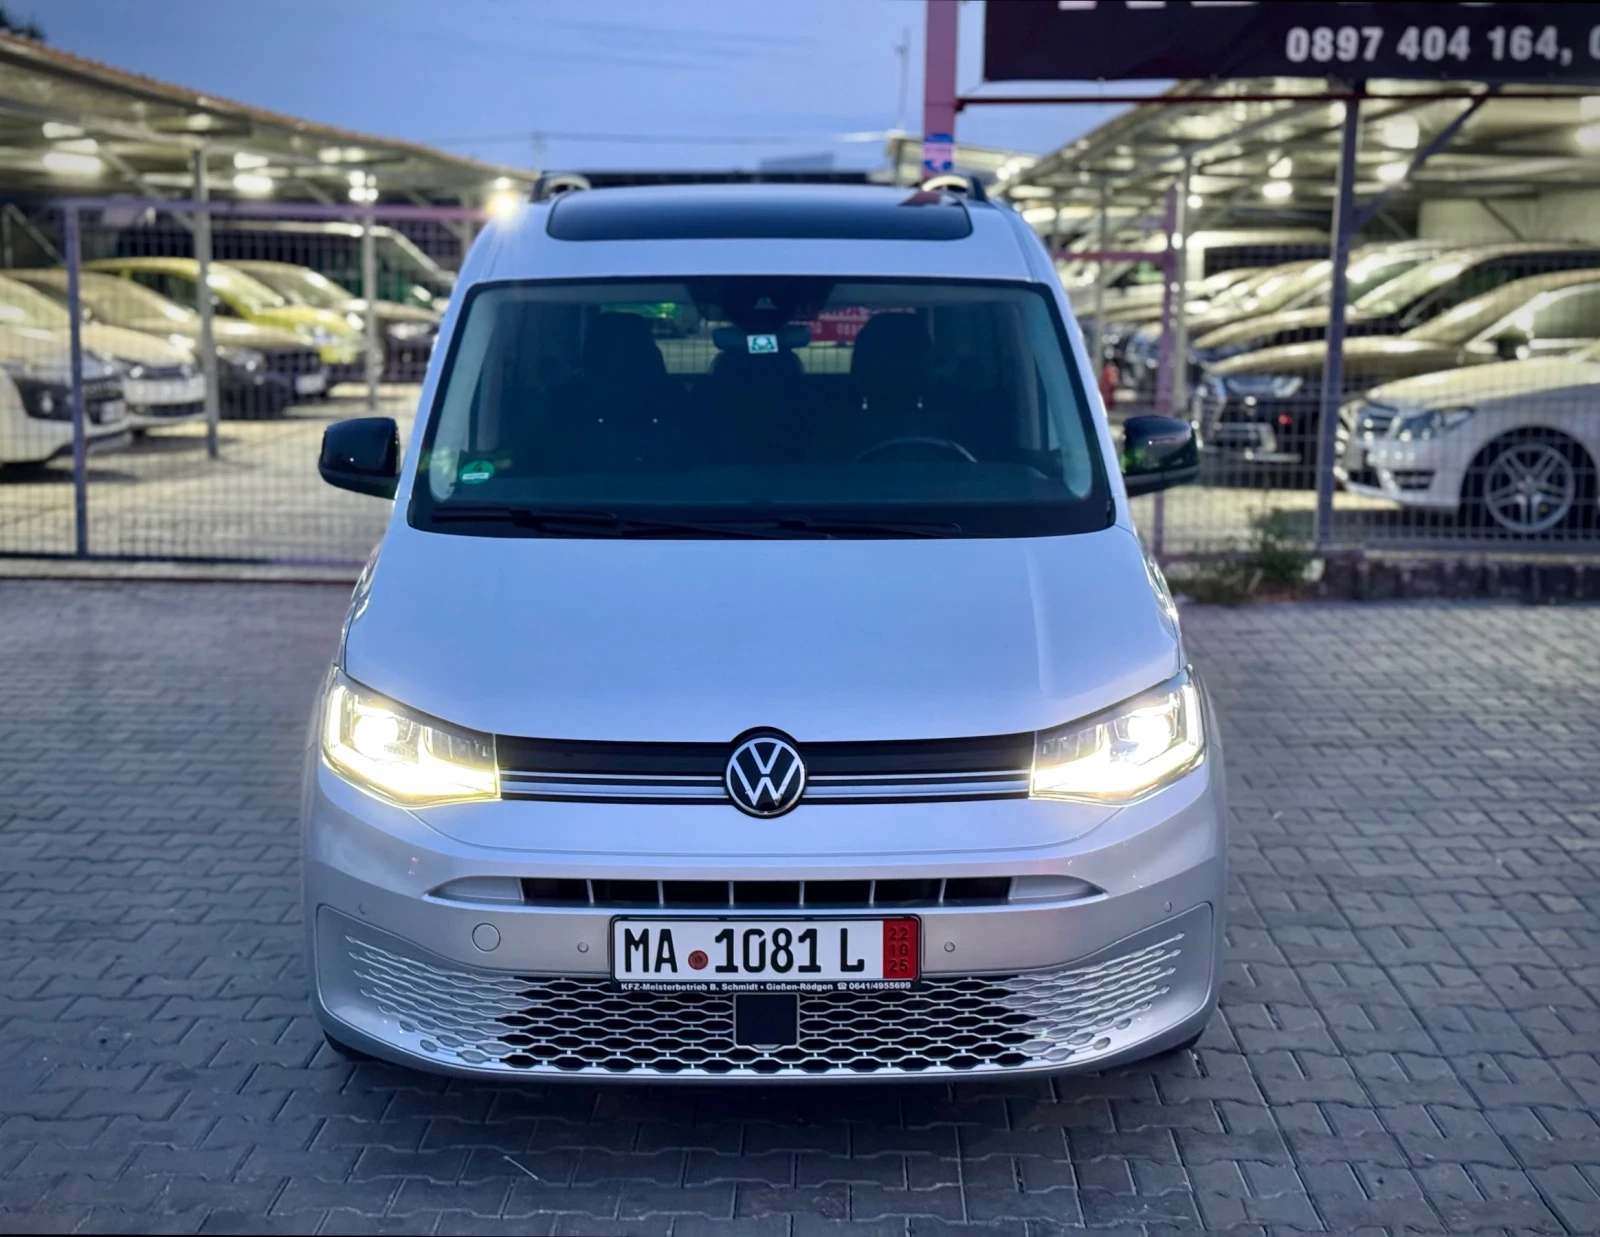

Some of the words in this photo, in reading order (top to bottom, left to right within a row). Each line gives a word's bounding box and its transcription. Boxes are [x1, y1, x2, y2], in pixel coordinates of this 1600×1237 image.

[1285, 26, 1384, 63] 0897
[1396, 25, 1471, 62] 404
[1486, 25, 1573, 66] 164,
[728, 741, 803, 807] VW
[888, 926, 909, 941] 22
[624, 928, 678, 973] MA
[714, 927, 822, 973] 1081
[840, 927, 866, 972] L
[889, 942, 909, 957] 10
[888, 958, 909, 972] 25
[621, 982, 707, 991] KFZ-Meisterbetrieb
[709, 983, 720, 991] B.
[721, 982, 759, 991] Schmidt
[765, 982, 833, 992] Gießen-Rödgen
[848, 981, 911, 990] 0641/4955699
